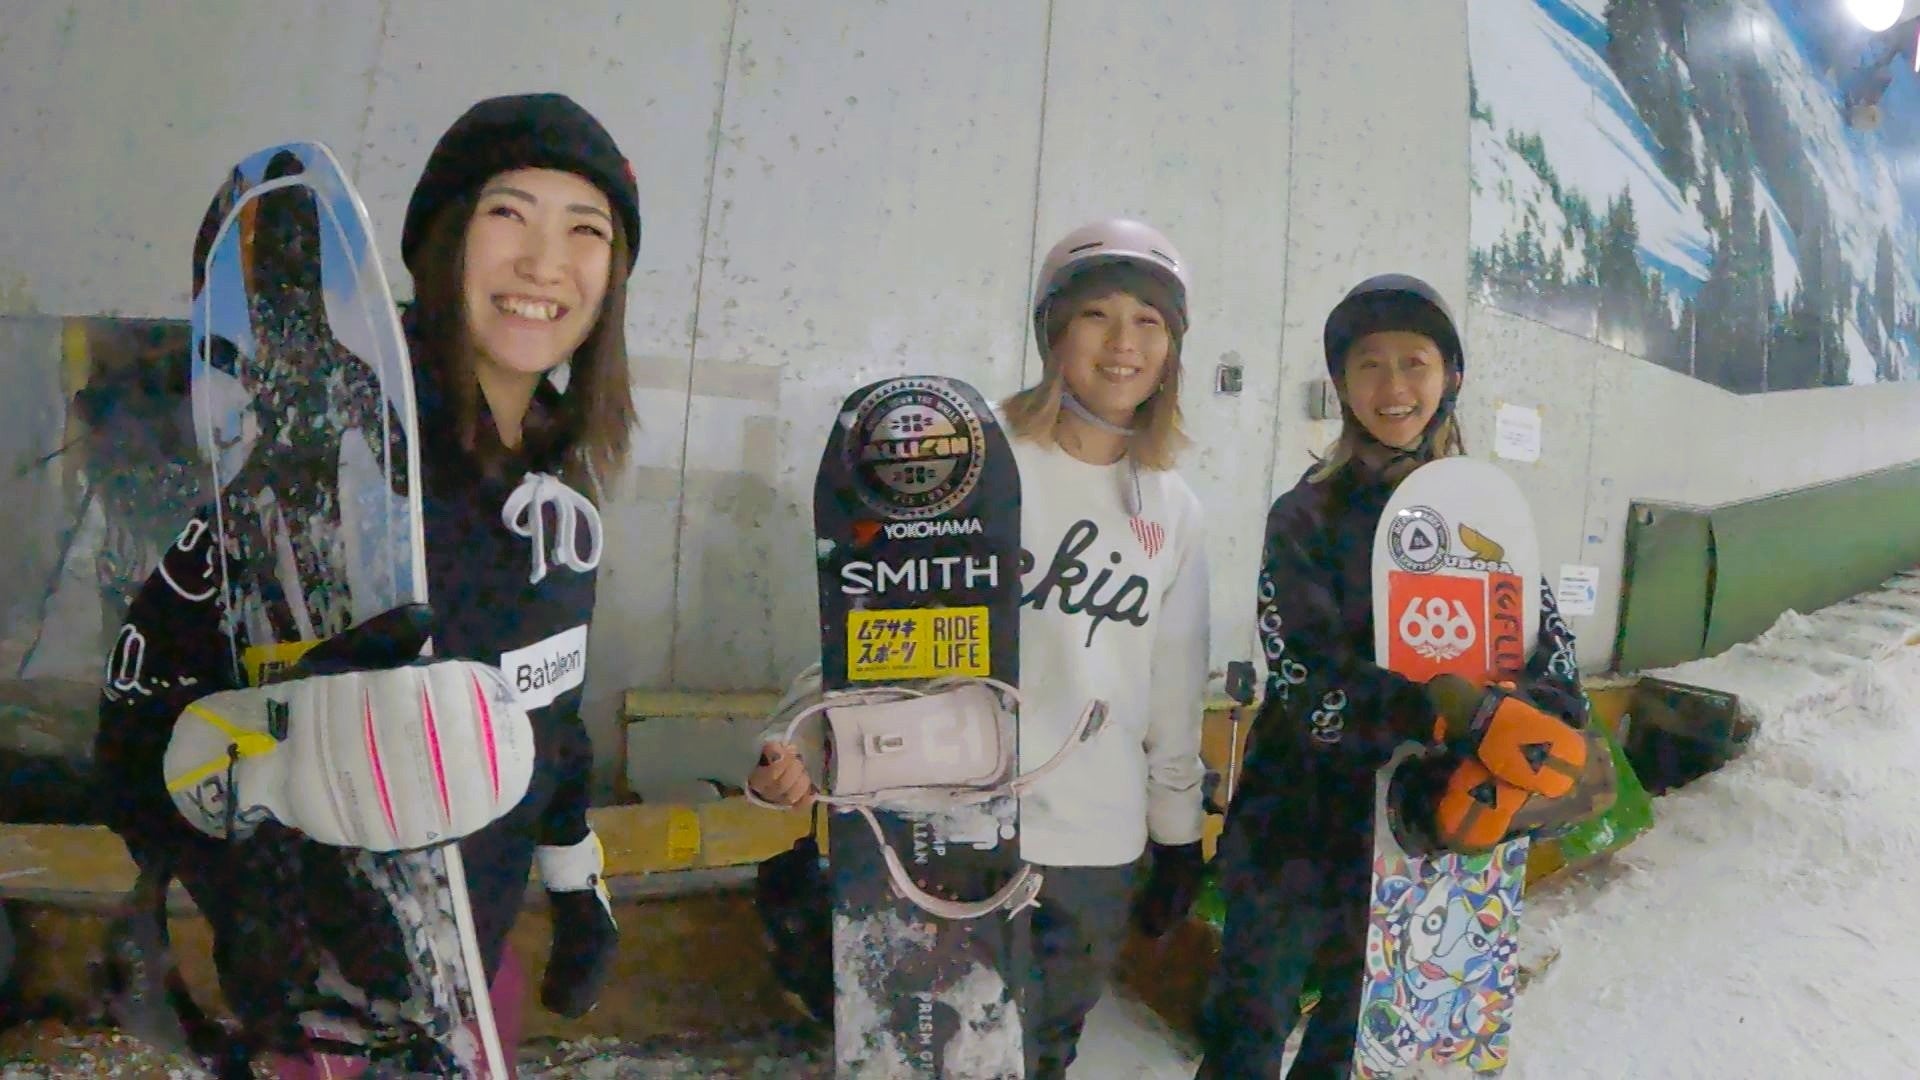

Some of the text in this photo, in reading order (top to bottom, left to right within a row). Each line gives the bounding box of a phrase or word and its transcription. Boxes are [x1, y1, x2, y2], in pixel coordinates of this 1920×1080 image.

[883, 516, 984, 540] YOKOHAMA
[839, 555, 1000, 595] SMITH
[857, 618, 917, 640] ムラサキ
[933, 615, 980, 641] RIDE
[1398, 596, 1477, 651] 686
[856, 641, 917, 664] スポーツ
[933, 643, 980, 668] LIFE
[516, 649, 582, 693] Bataleon
